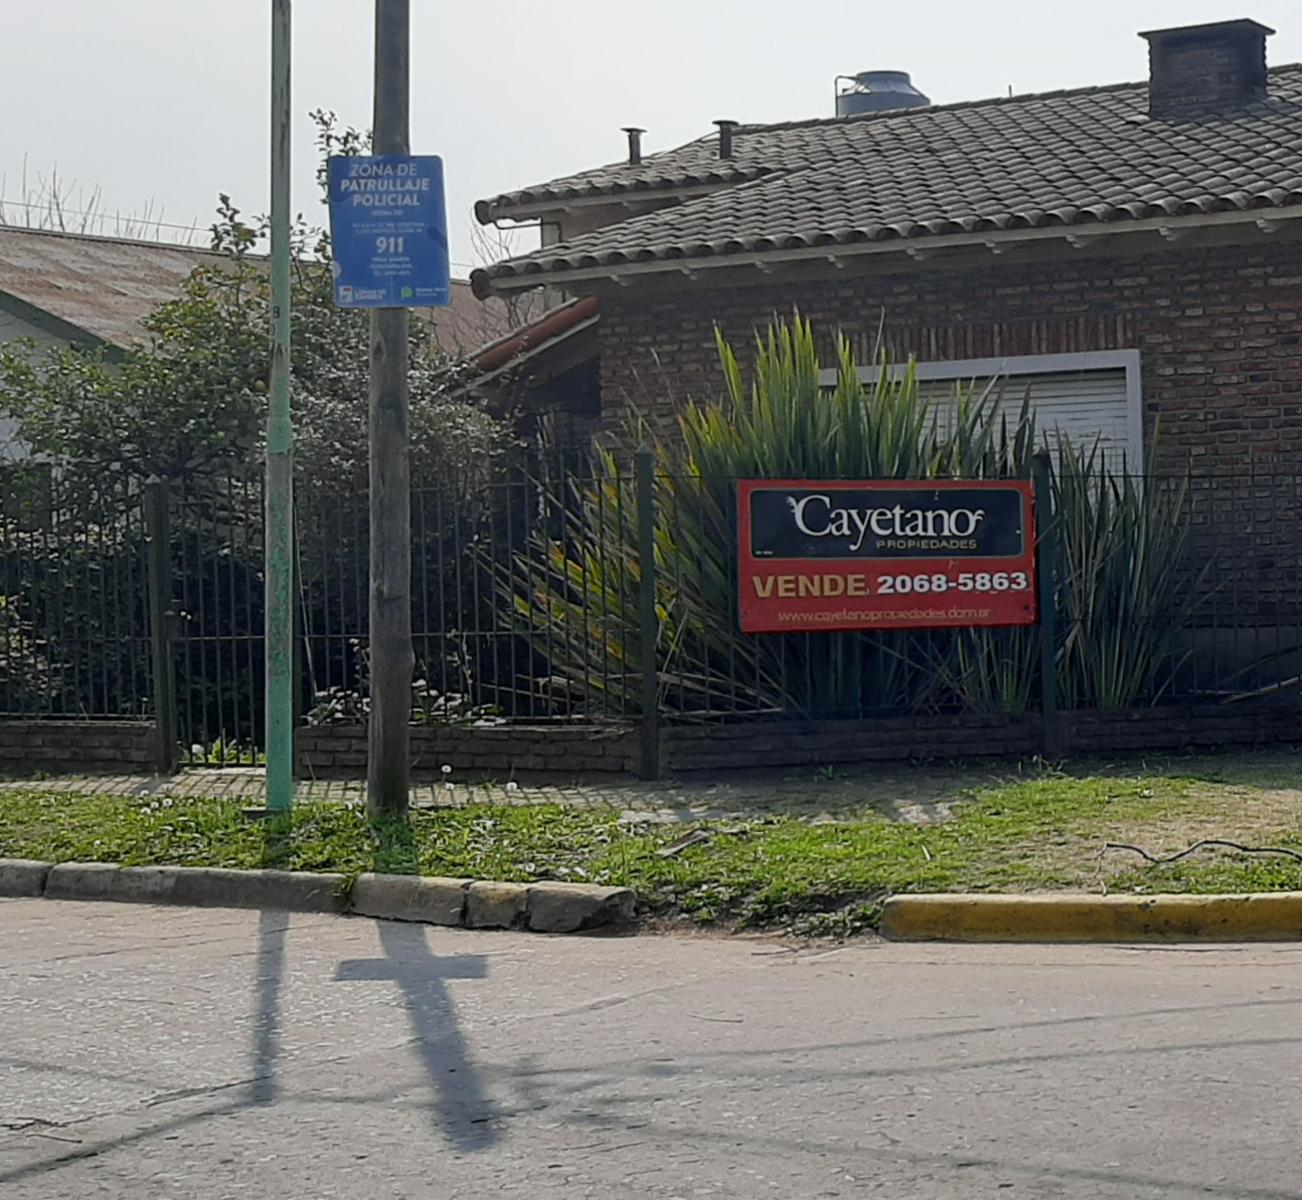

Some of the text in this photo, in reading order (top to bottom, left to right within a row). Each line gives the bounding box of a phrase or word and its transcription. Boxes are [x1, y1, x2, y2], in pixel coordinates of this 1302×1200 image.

[350, 163, 417, 177] ZONA DE
[340, 178, 431, 192] PATRULLAJE
[352, 194, 421, 206] POLICIAL
[376, 236, 405, 253] 911
[785, 494, 985, 551] Cayetano
[876, 539, 977, 550] PROPIEDADES
[752, 572, 1028, 598] VENDE 2068-5863
